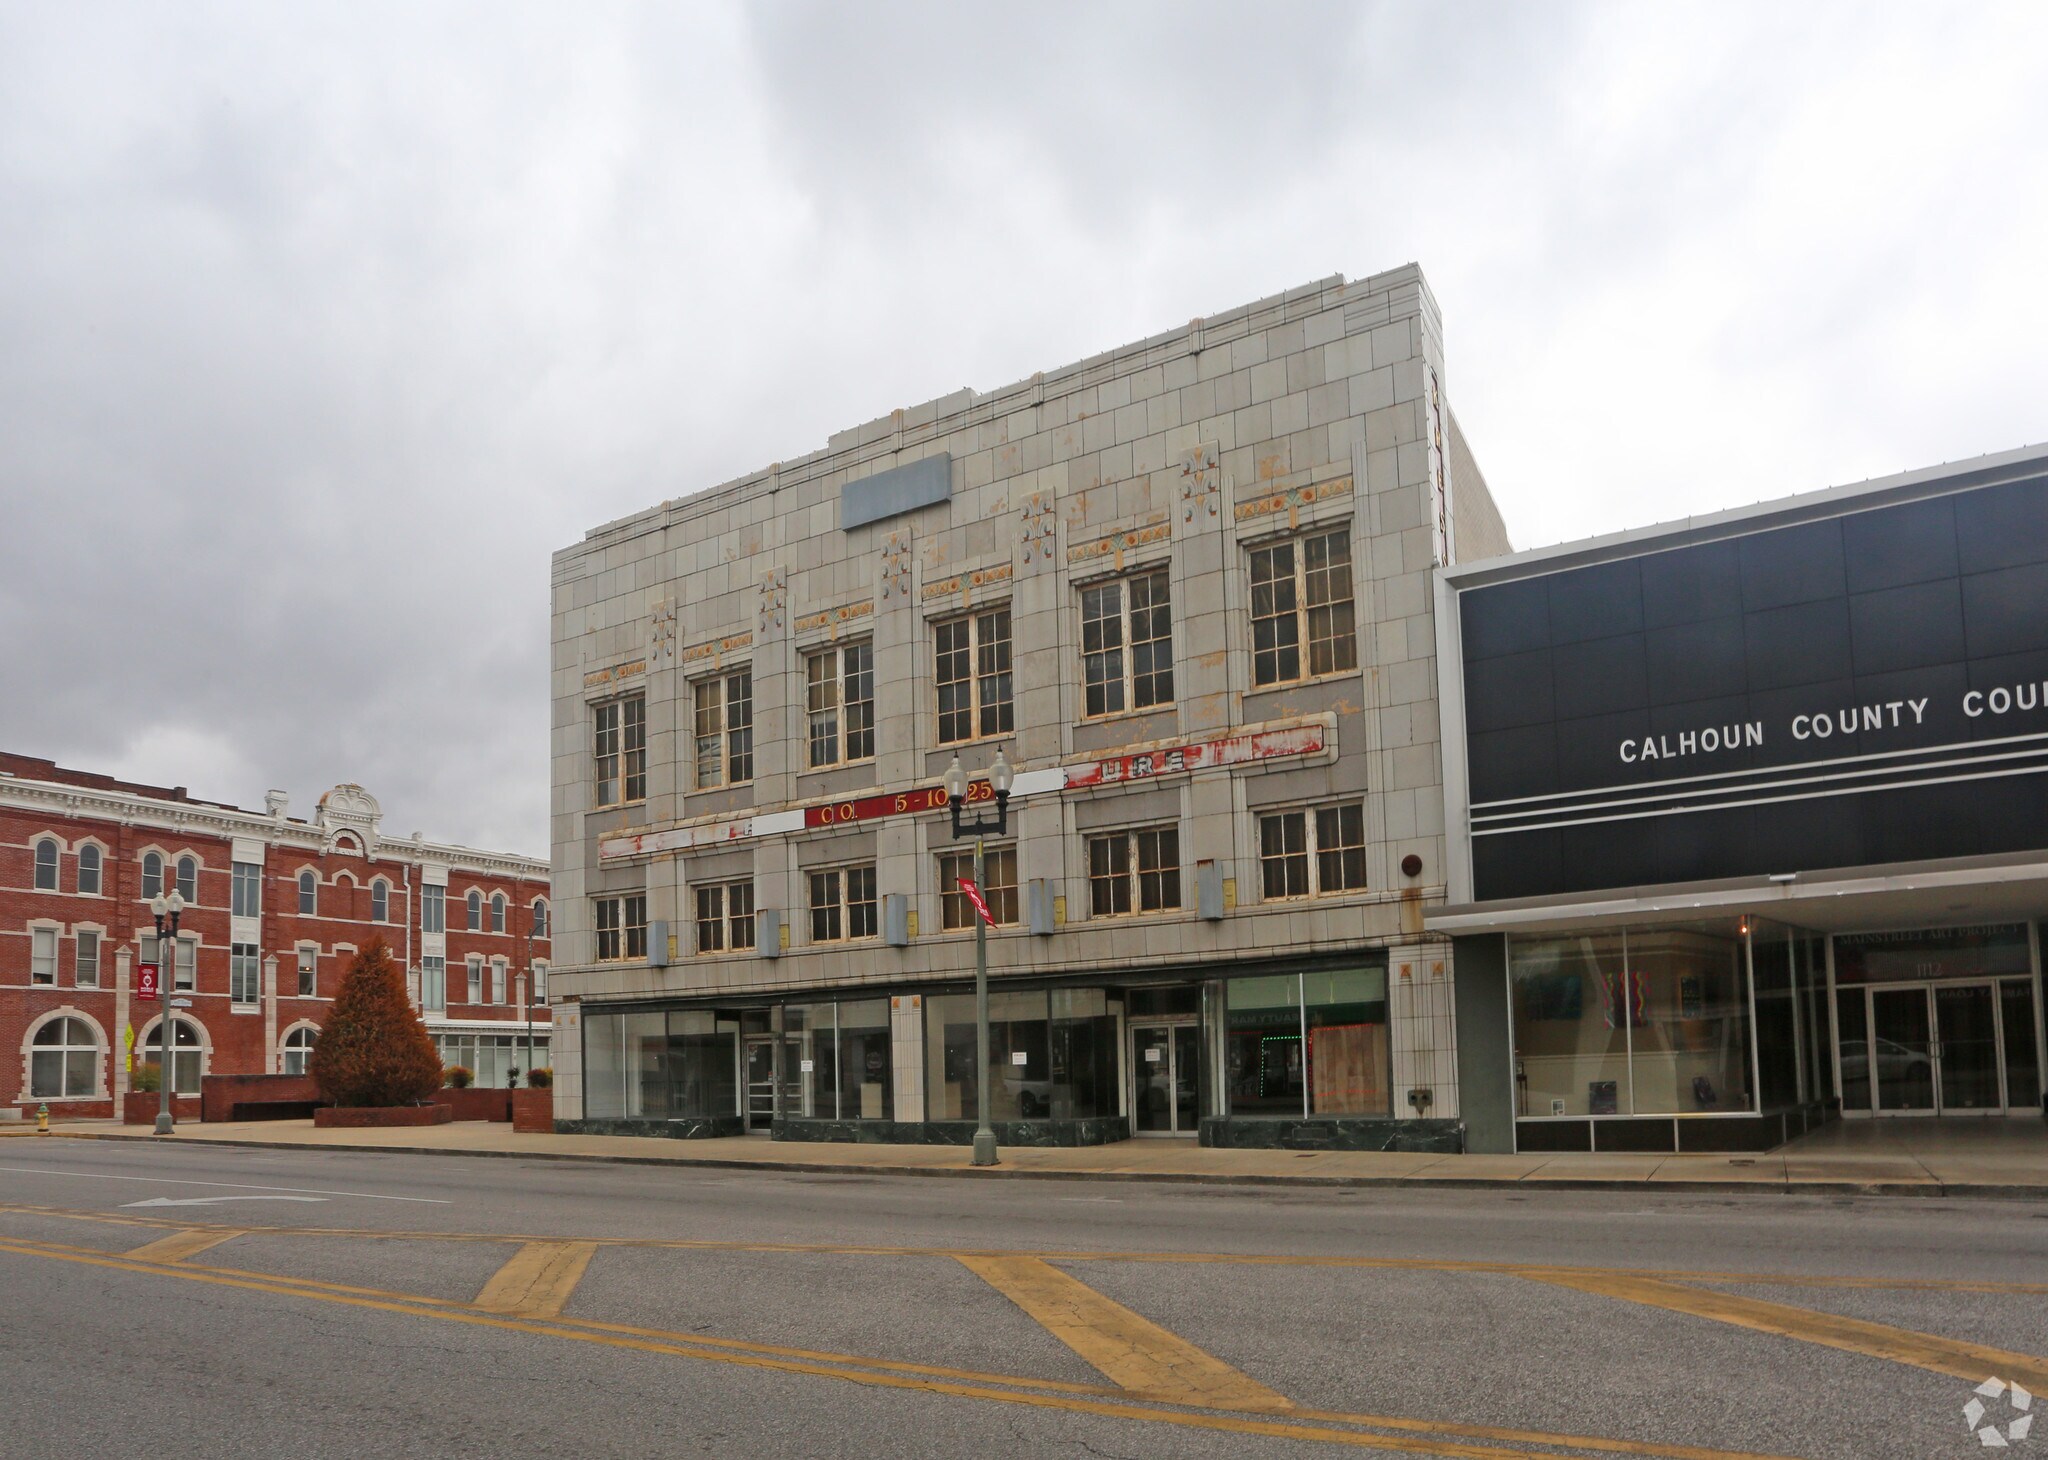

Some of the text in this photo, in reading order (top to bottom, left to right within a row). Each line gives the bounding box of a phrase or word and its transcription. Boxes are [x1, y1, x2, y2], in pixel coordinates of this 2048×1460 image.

[1619, 681, 2048, 763] CALHOUN COUNTY COU
[1929, 927, 1953, 940] ART
[1916, 963, 1942, 977] 1112
